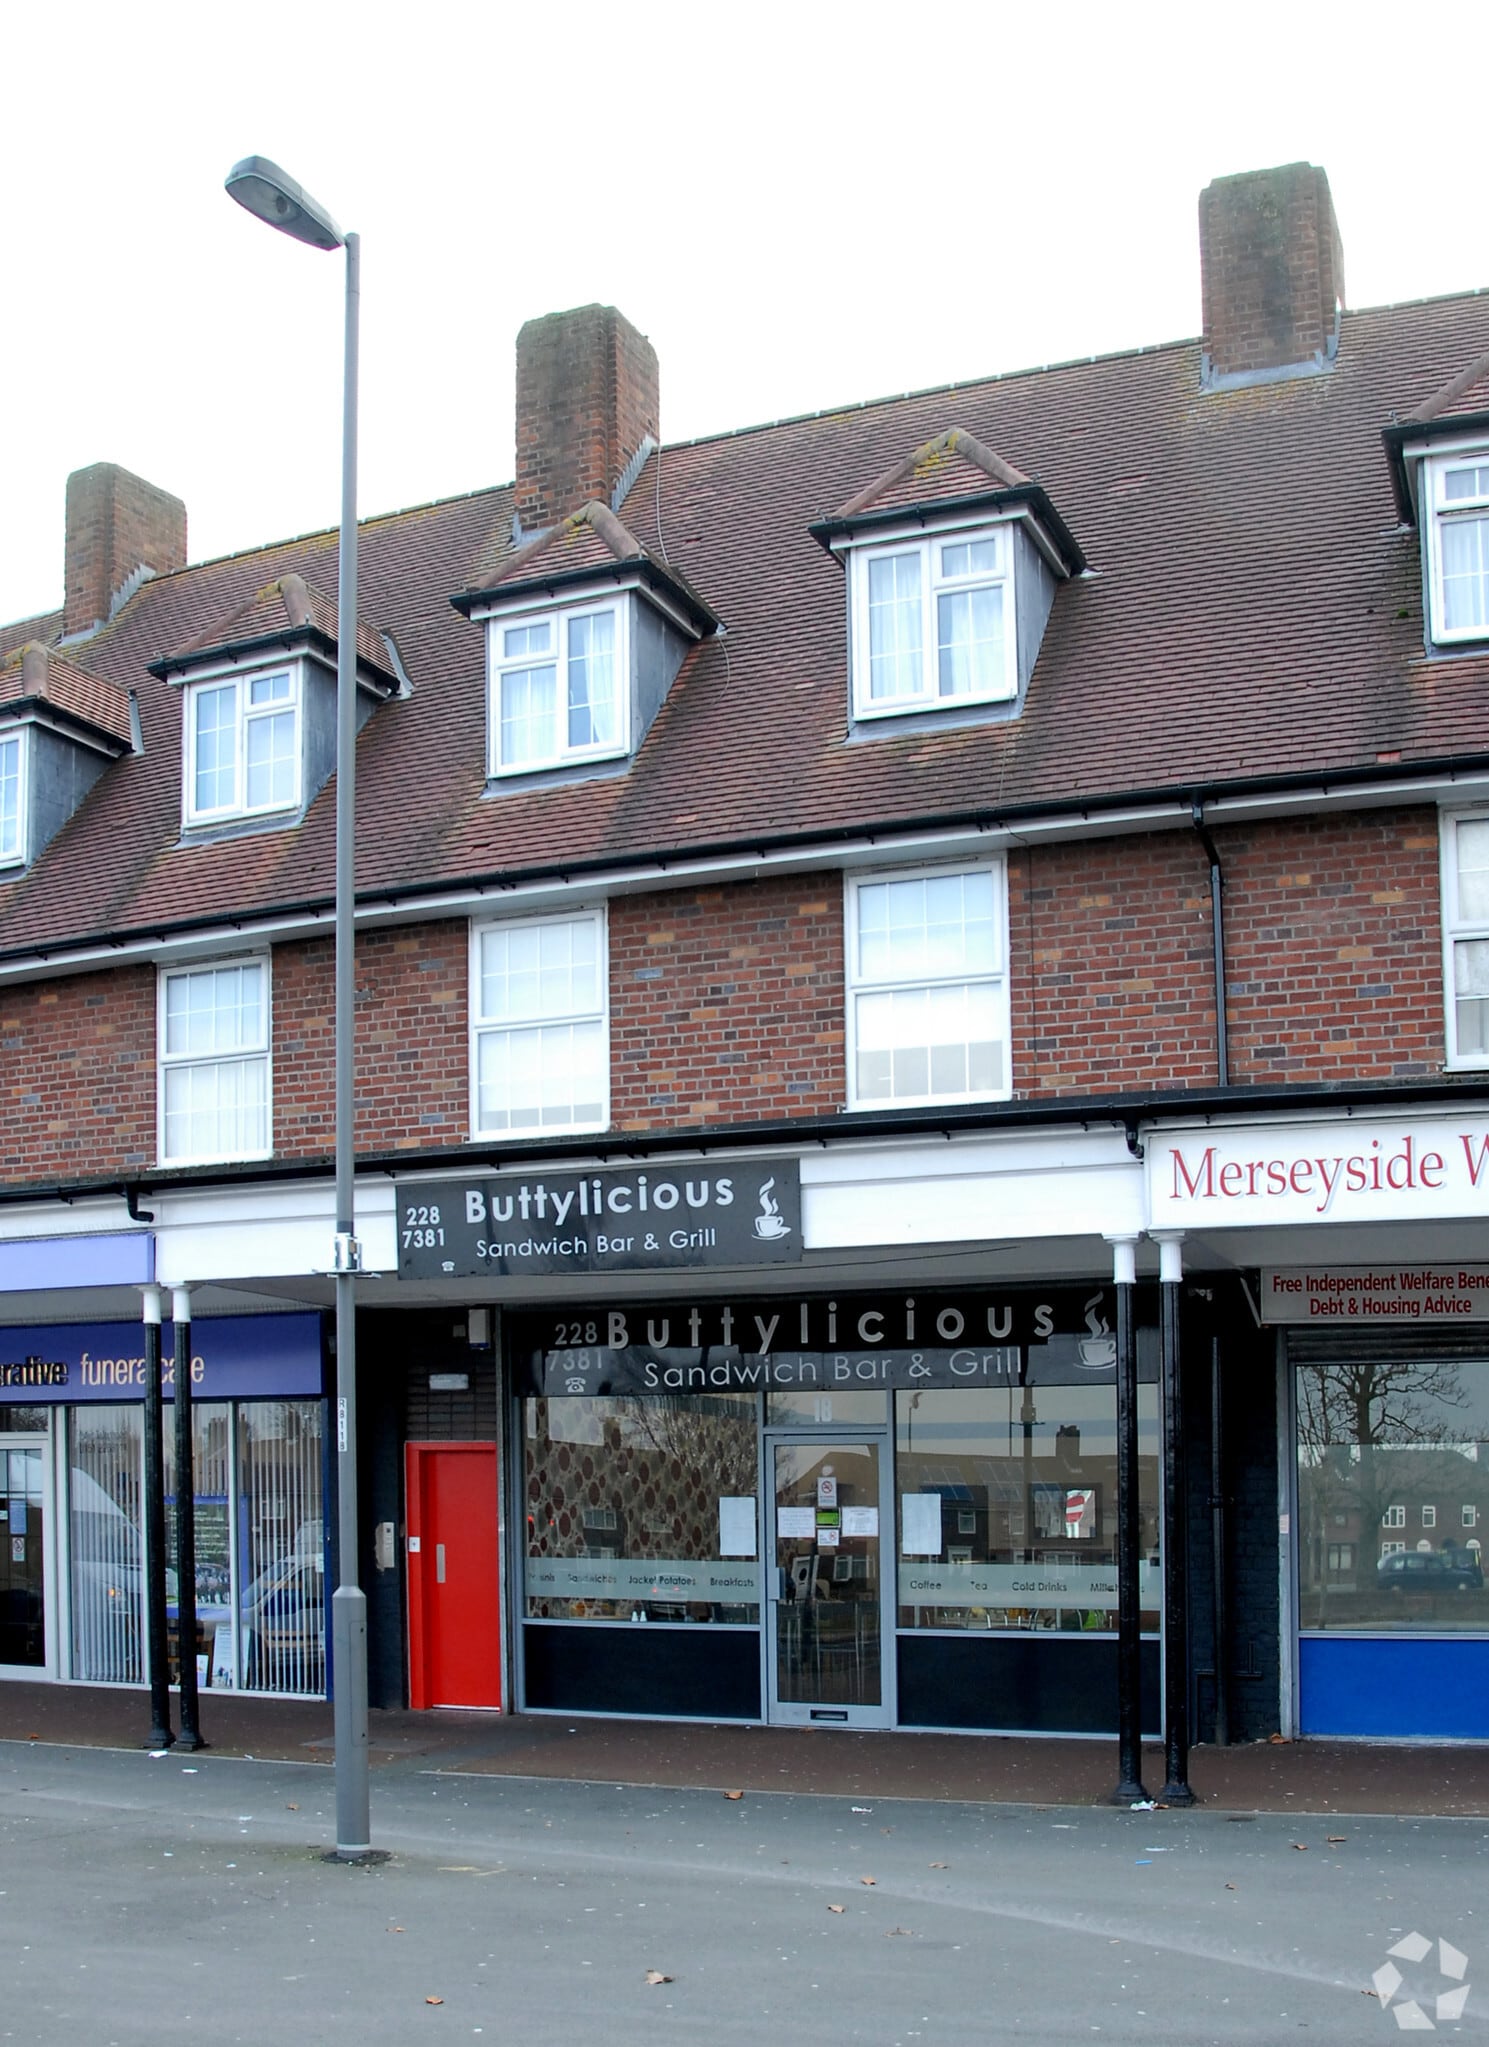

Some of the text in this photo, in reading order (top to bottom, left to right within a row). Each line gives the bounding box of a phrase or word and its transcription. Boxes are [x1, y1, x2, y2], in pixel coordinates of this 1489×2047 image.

[1169, 1136, 1444, 1212] Merseyside
[465, 1175, 734, 1226] Buttylicious
[406, 1206, 441, 1226] 228
[402, 1228, 445, 1249] 7381
[476, 1228, 716, 1258] Sandwich Bar & Grill
[1273, 1274, 1302, 1292] Free
[1306, 1273, 1396, 1296] Independent
[1399, 1271, 1455, 1290] Welfare
[1310, 1294, 1472, 1318] Debt & Housing Advice
[555, 1321, 598, 1345] 228
[608, 1298, 1054, 1355] Buttylicious
[548, 1347, 602, 1371] 7381
[644, 1346, 1022, 1387] Sandwich Bar & Grill
[659, 1575, 696, 1586] Potatoes
[710, 1577, 754, 1588] Breakfasts
[909, 1580, 942, 1591] Coffee
[1011, 1581, 1035, 1592] Cold
[1038, 1581, 1068, 1593] Drinks
